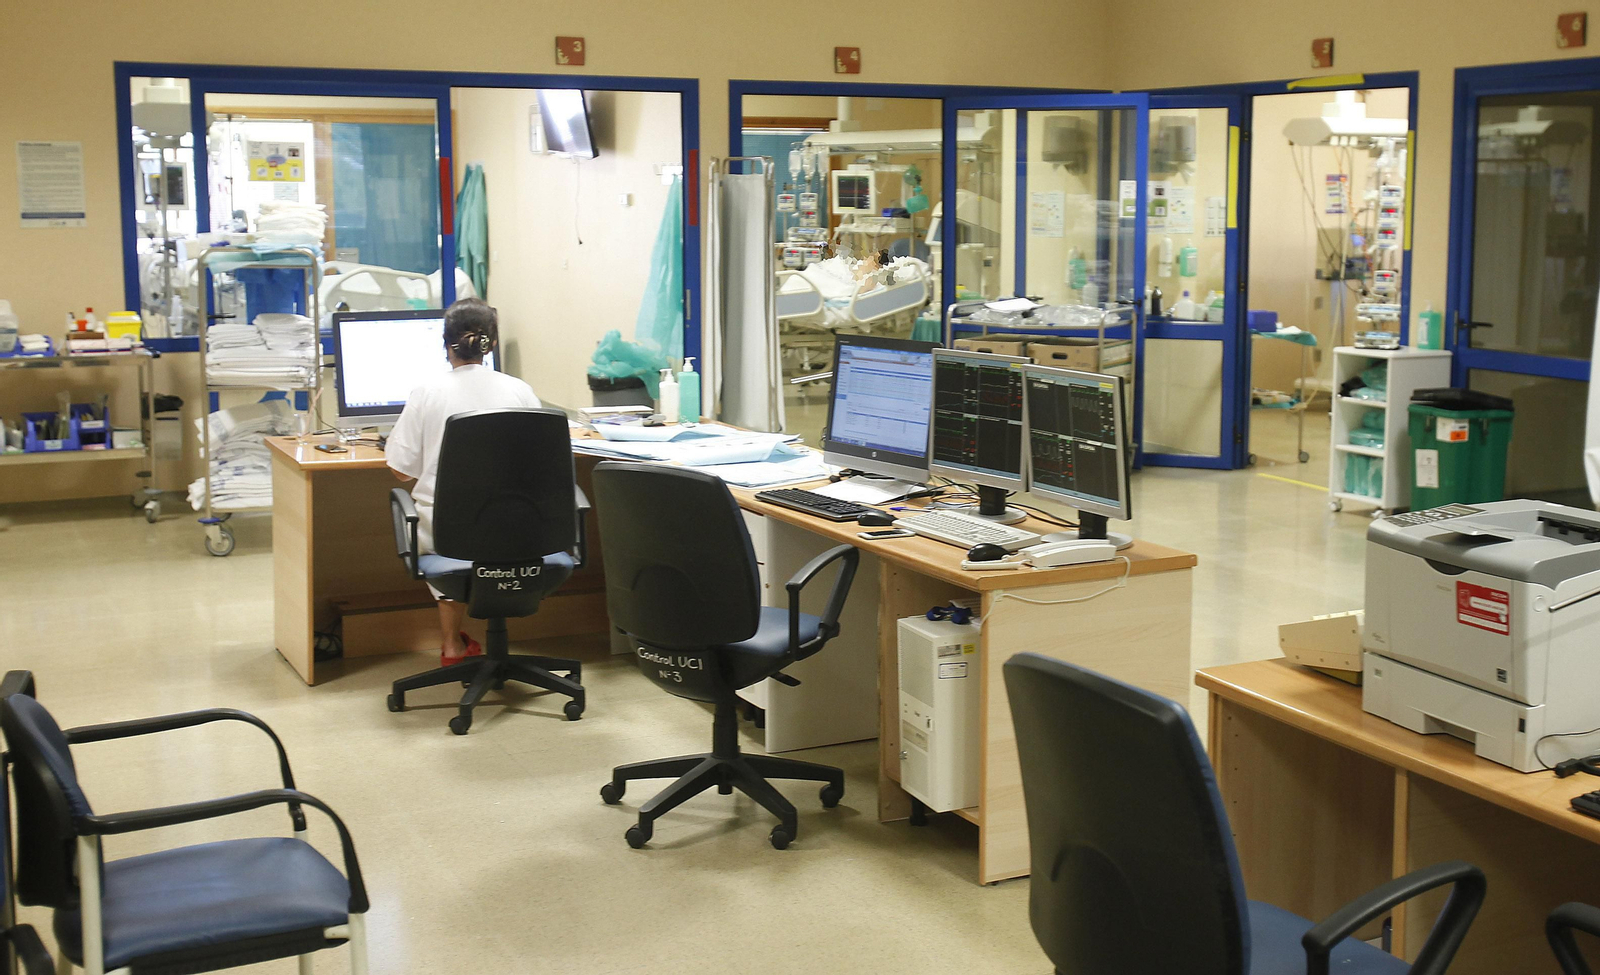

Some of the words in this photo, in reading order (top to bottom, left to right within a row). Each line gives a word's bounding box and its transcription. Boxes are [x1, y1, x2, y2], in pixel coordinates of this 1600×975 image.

[1572, 16, 1581, 31] 6
[573, 40, 583, 52] 3
[1322, 41, 1330, 54] 5
[850, 50, 858, 61] 4
[476, 566, 516, 578] Control
[520, 566, 541, 577] UCI
[637, 646, 675, 667] Control
[678, 656, 703, 671] UCI
